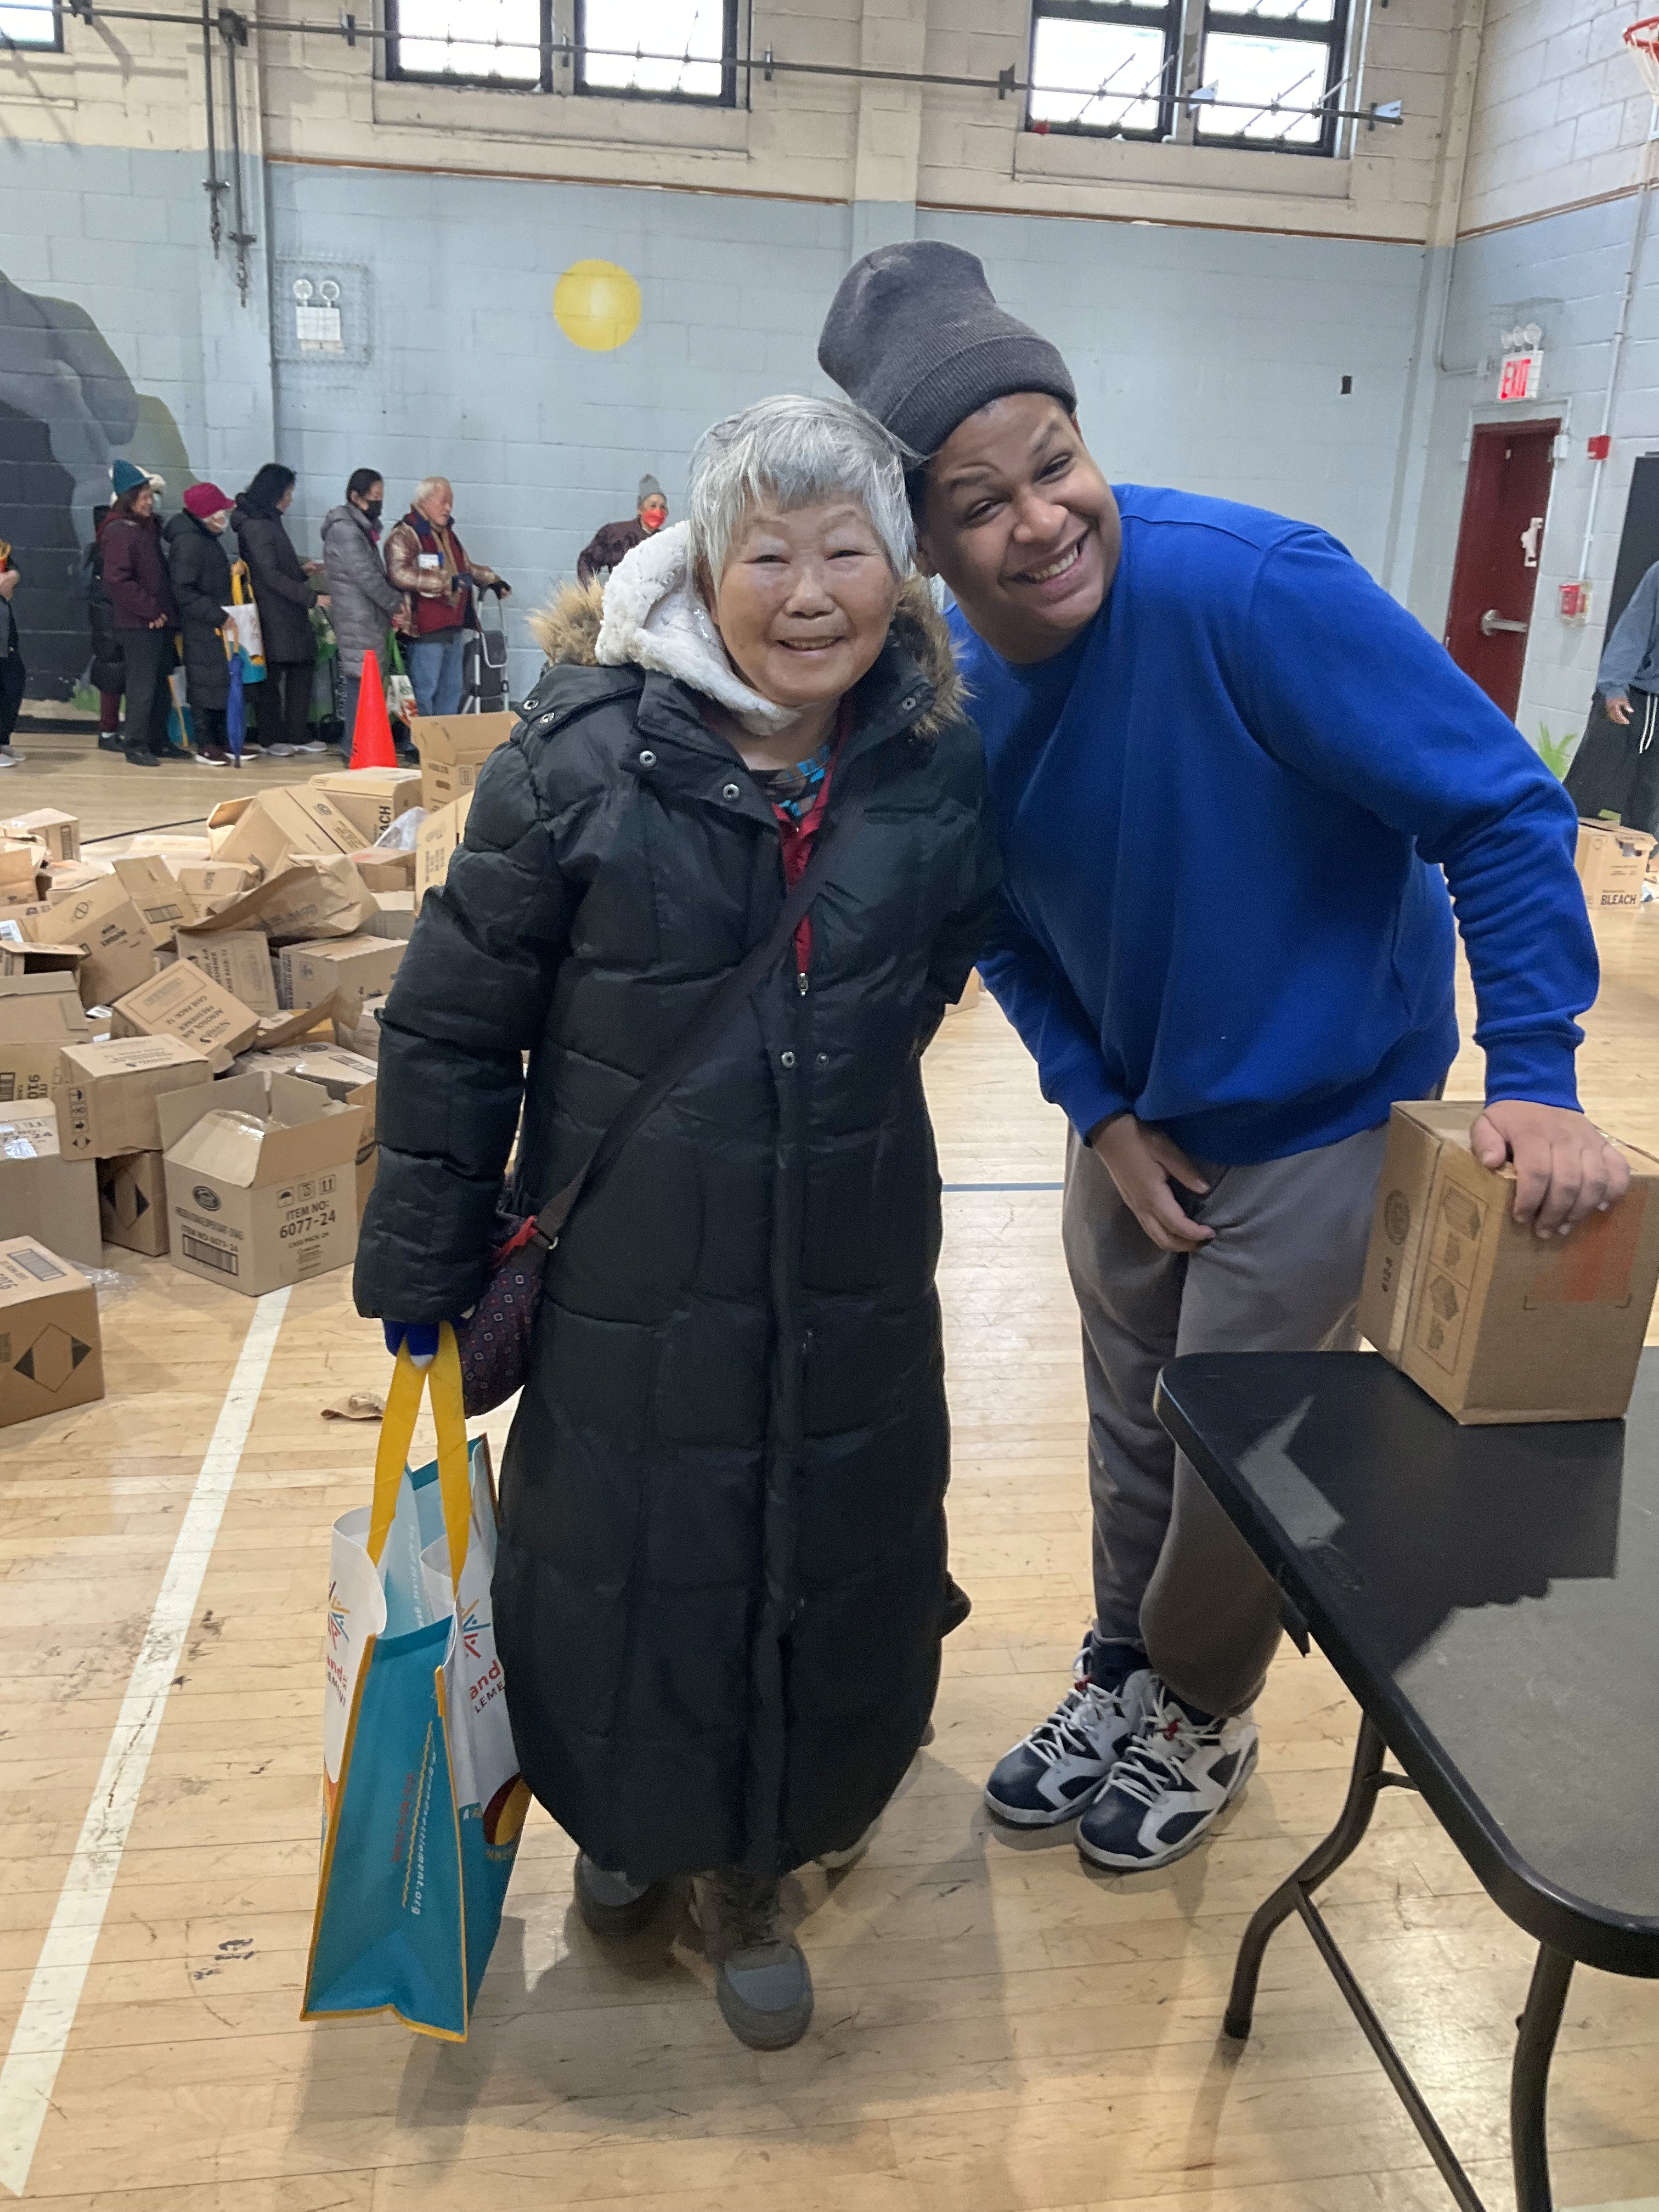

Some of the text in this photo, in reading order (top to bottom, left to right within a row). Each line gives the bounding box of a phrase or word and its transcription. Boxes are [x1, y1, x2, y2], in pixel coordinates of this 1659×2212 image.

[1501, 358, 1531, 399] EXIT
[379, 805, 391, 837] ACH
[1601, 894, 1637, 905] BLEACH
[177, 1005, 214, 1031] FRESHENER
[194, 1008, 223, 1029] AEROSOL
[182, 1028, 195, 1039] AIR
[279, 1210, 336, 1238] 6077-24
[286, 1205, 311, 1221] ITEM
